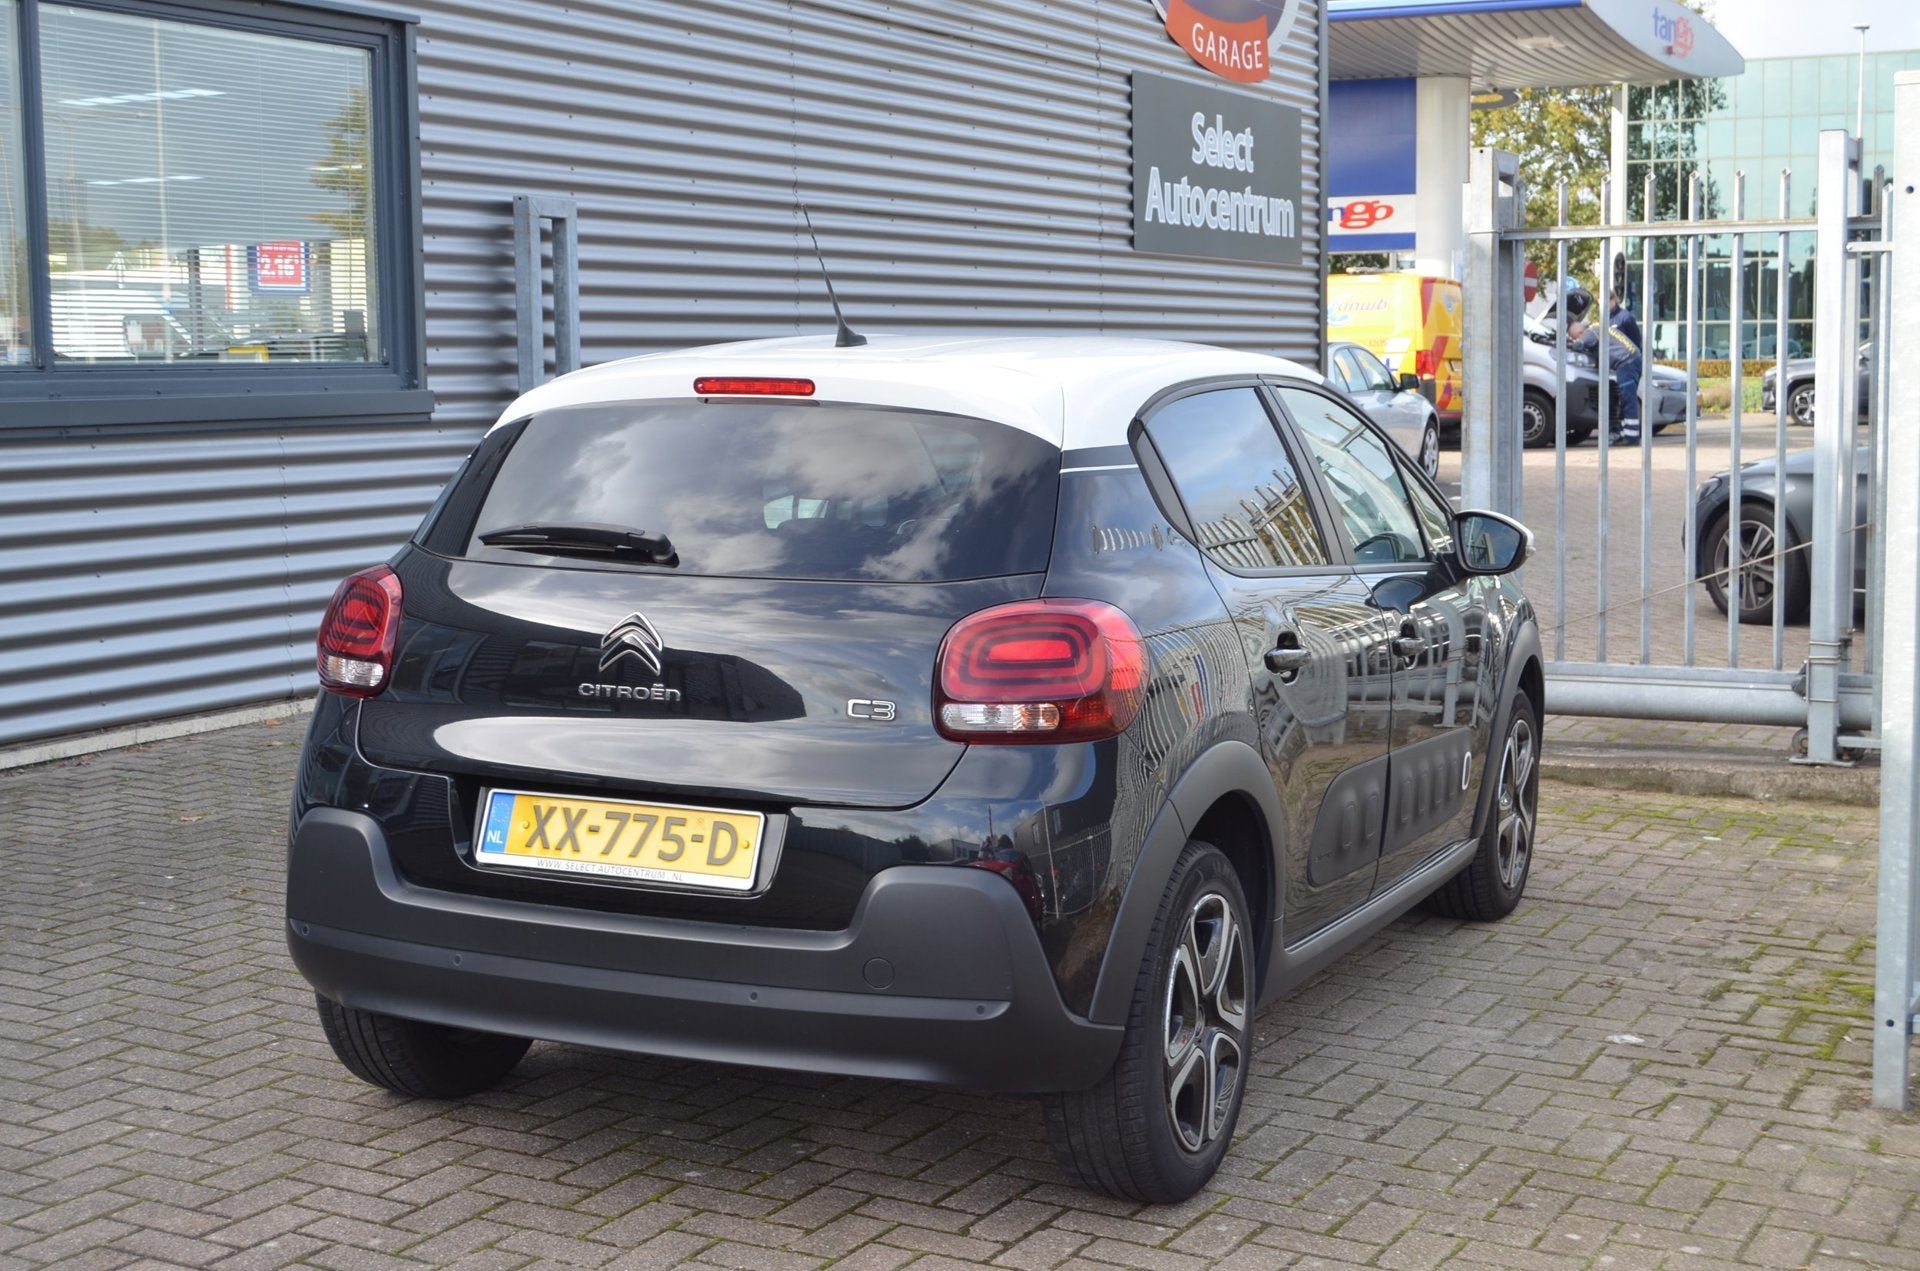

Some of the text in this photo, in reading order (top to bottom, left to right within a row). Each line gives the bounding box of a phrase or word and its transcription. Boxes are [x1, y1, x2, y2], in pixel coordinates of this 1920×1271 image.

[1191, 22, 1264, 71] GARAGE
[1652, 7, 1695, 60] tango
[1191, 111, 1255, 174] Select
[1144, 166, 1295, 239] Autocentrum
[1327, 200, 1394, 230] ngo
[1337, 297, 1389, 313] anwb
[577, 683, 682, 702] CITROËN
[847, 699, 896, 721] C3
[486, 829, 504, 844] NL
[525, 804, 739, 866] XX-775-D
